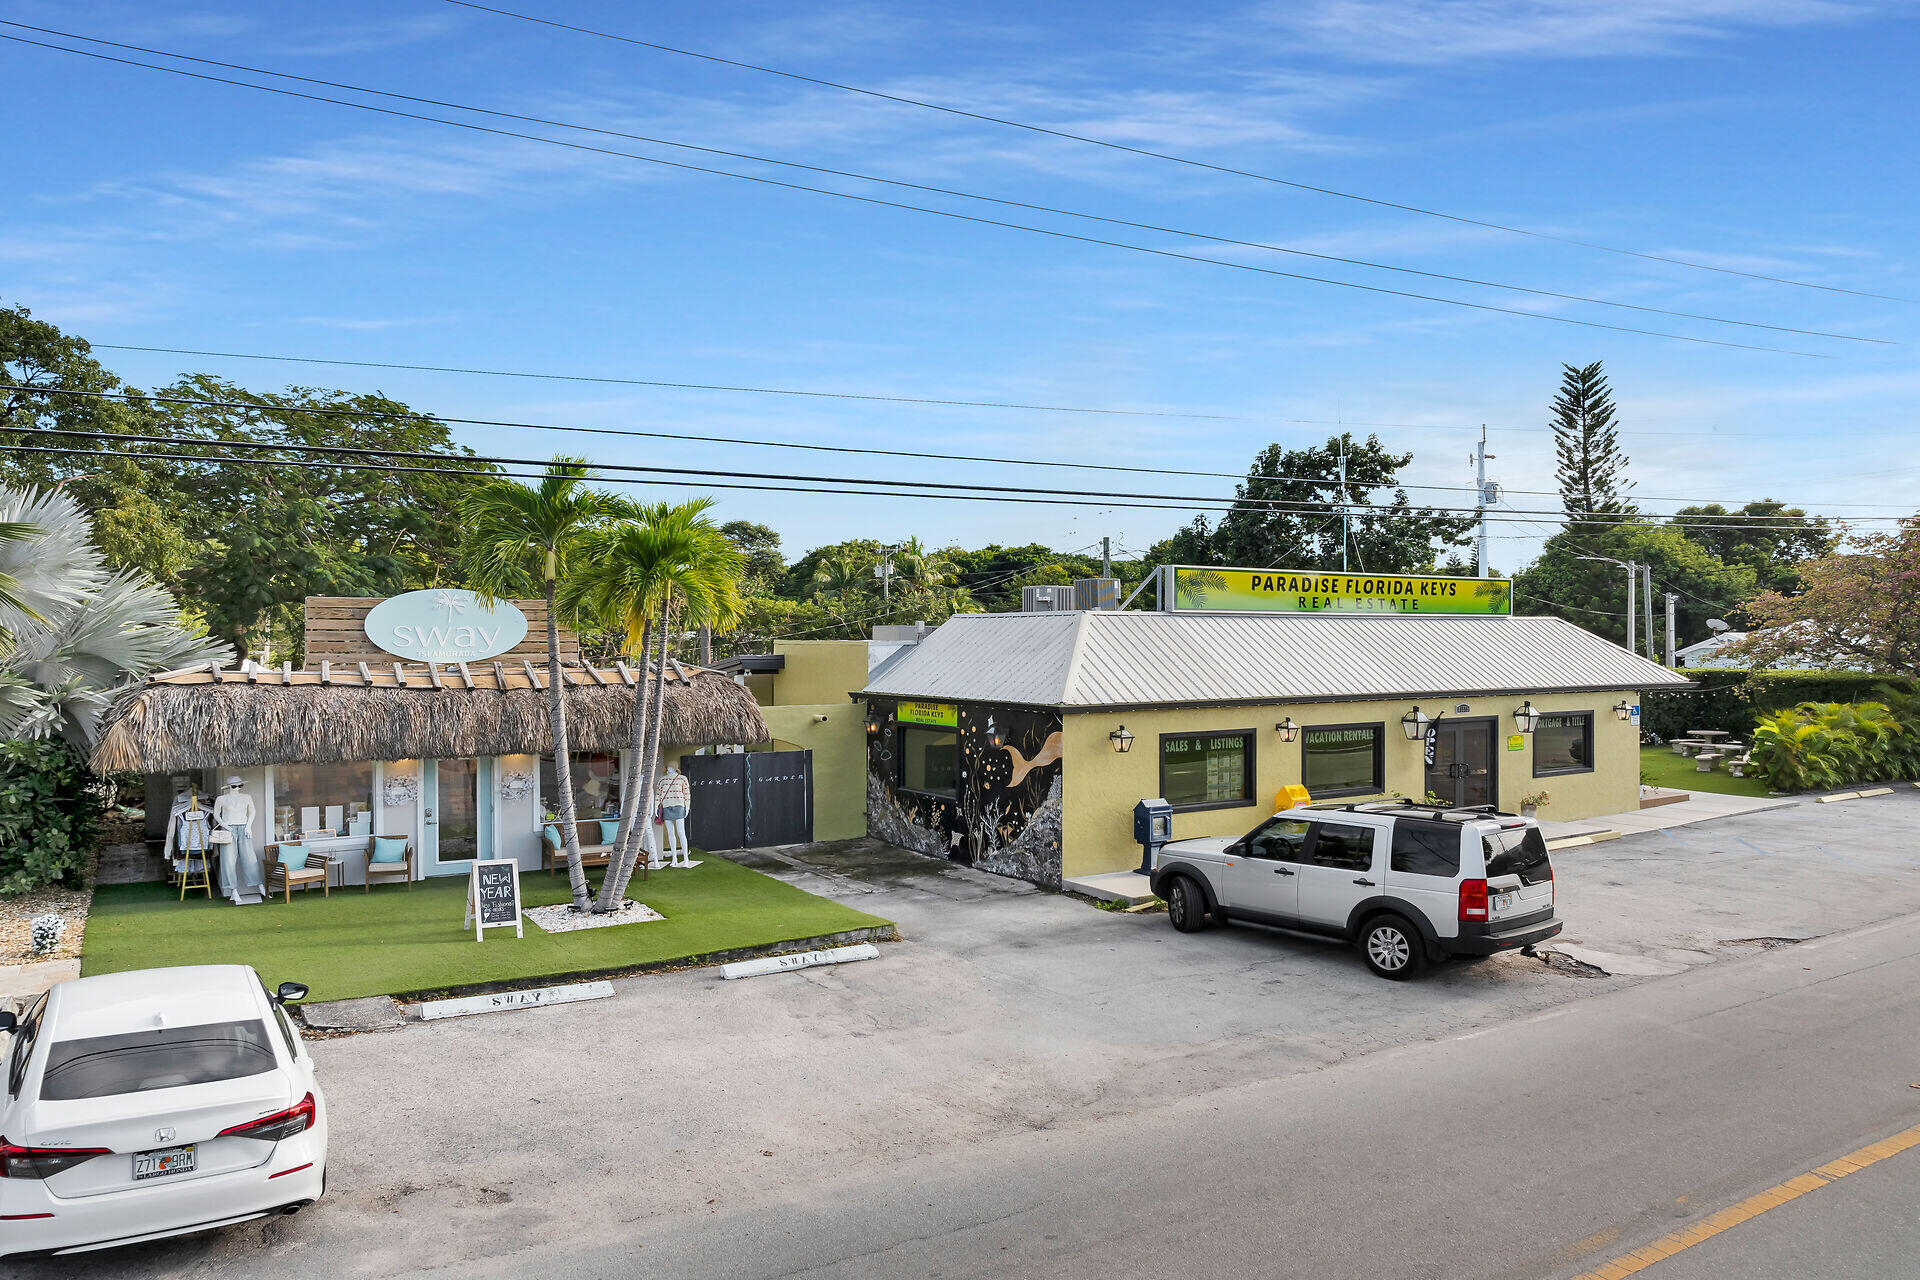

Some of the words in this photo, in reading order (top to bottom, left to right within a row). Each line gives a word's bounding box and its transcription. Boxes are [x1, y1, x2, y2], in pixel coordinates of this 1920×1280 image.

[1251, 575, 1339, 594] PARADISE
[1346, 578, 1414, 596] FLORIDA
[1420, 580, 1457, 597] KEYS
[1298, 596, 1344, 609] REAL
[1355, 597, 1419, 611] ESTATE
[392, 625, 500, 653] sway
[417, 650, 476, 658] ISLAMORADA
[910, 709, 931, 717] FLORIDA
[914, 702, 939, 711] PARADISE
[1566, 718, 1571, 727] &
[1572, 716, 1585, 726] TITLE
[1305, 730, 1342, 744] VACATION
[1343, 729, 1374, 742] RENTALS
[1165, 740, 1188, 753] SALES
[1195, 739, 1202, 751] &
[1210, 737, 1244, 750] LISTINGS
[692, 778, 738, 787] SECRET
[482, 873, 511, 885] NEW
[480, 885, 512, 901] YEAR
[779, 953, 819, 967] SWAY
[492, 992, 541, 1007] SWAY
[136, 1158, 156, 1174] Z71
[171, 1152, 193, 1168] 9RM
[143, 1169, 168, 1180] LARGO
[168, 1165, 192, 1175] HONDA
